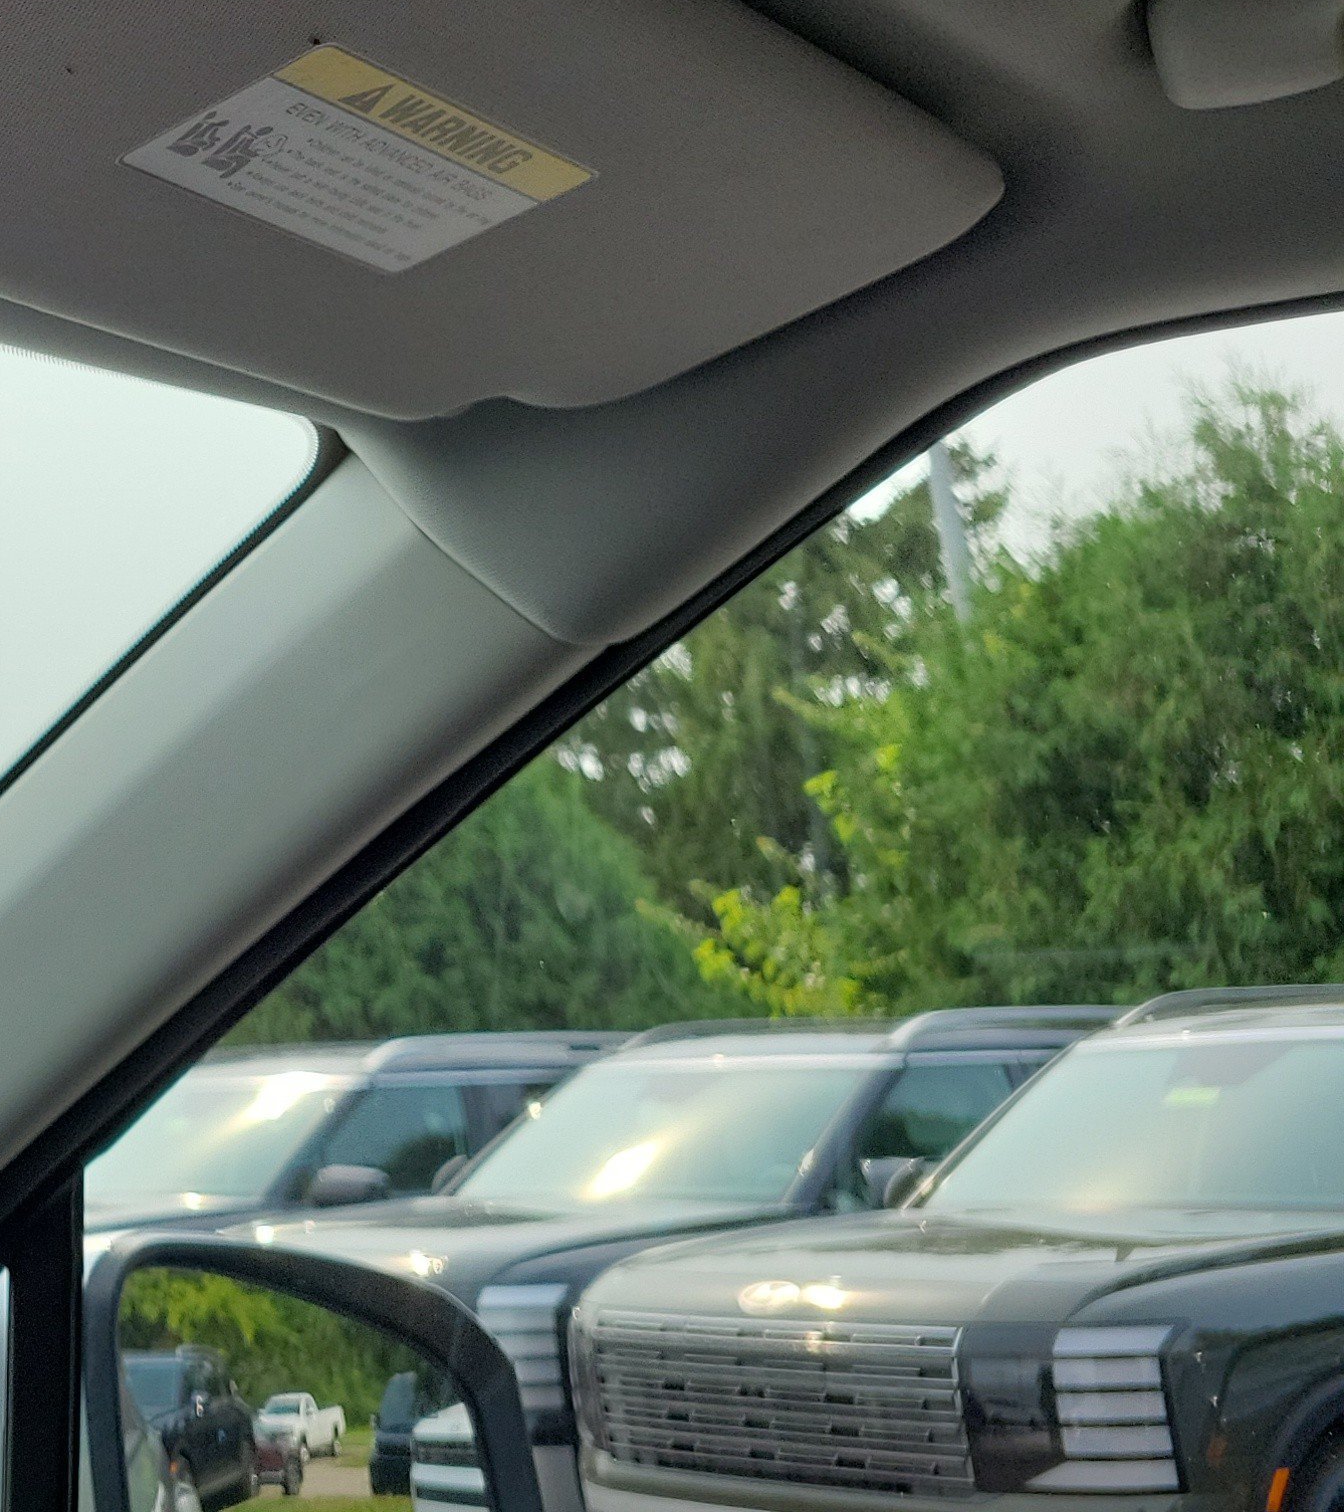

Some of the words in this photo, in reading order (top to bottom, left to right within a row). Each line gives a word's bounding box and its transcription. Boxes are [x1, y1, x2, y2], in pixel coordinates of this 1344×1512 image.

[285, 101, 330, 127] EVEN
[325, 119, 363, 141] WITH
[377, 93, 533, 175] WARNING
